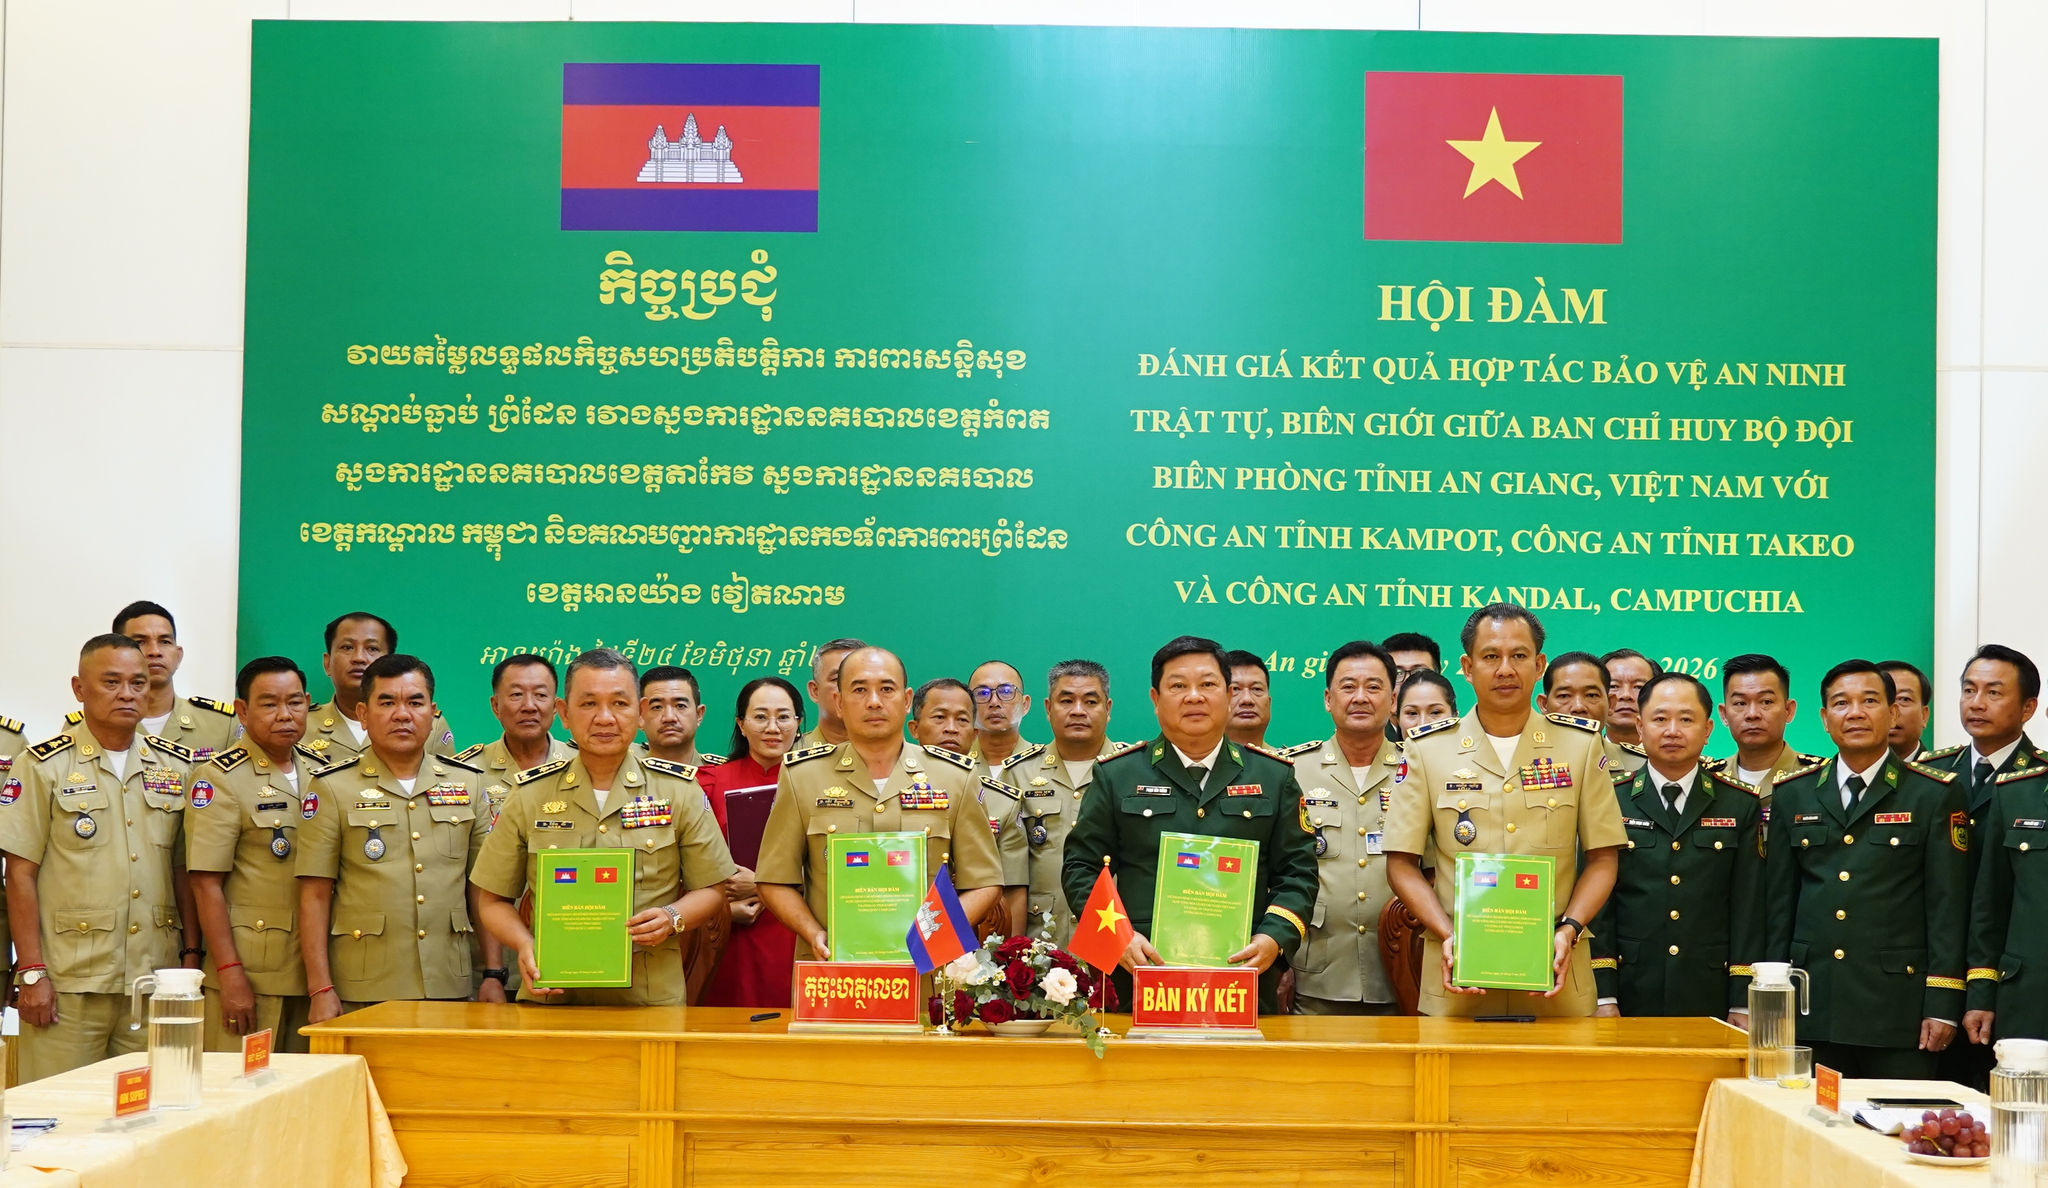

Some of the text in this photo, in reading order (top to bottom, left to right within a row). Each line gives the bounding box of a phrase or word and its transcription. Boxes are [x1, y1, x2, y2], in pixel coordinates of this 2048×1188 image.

[600, 250, 777, 321] កិច្ចប្រជុំ
[1378, 277, 1607, 332] HỘI ĐÀM
[1138, 348, 1846, 390] ĐÁNH GIÁ KẾT QUẢ HỢP TÁC BẢO VỆ AN NINH
[488, 395, 577, 432] ព្រំដែន
[1130, 406, 1854, 448] TRẬT TỰ, BIÊN GIỚI GIỮA BAN CHỈ HUY BỘ ĐỘI
[1153, 460, 1829, 502] BIÊN PHÒNG TỈNH AN GIANG, VIỆT NAM VỚI
[462, 521, 538, 561] កម្ពុជា
[1126, 517, 1855, 558] CÔNG AN TỈNH KAMPOT, CÔNG AN TỈNH TAKEO
[711, 572, 846, 613] វៀតណាម
[1174, 575, 1805, 615] VÀ CÔNG AN TỈNH KANDAL, CAMPUCHIA
[1661, 656, 1719, 680] 2026
[805, 976, 910, 1009] តុចុះហត្ថលេខា
[1143, 980, 1248, 1013] BÀN KÝ KẾT
